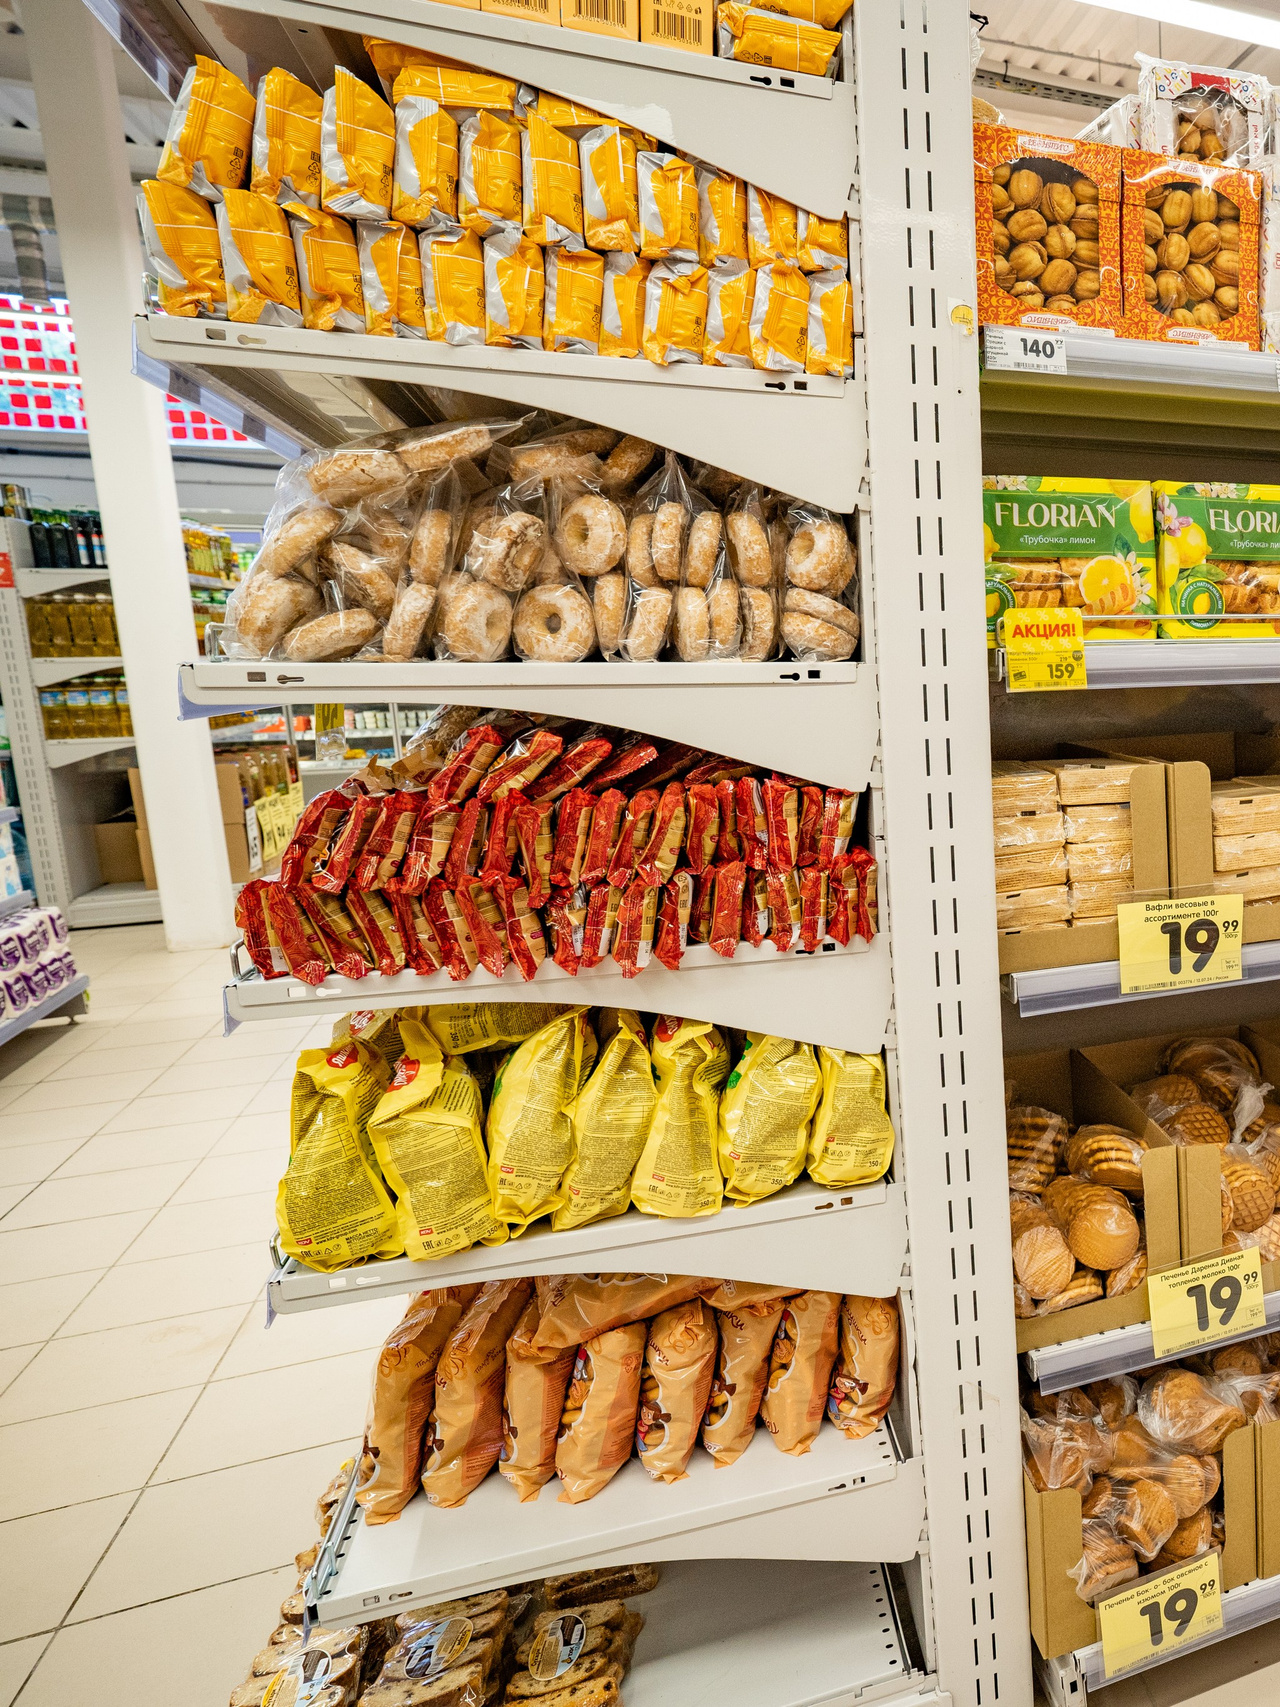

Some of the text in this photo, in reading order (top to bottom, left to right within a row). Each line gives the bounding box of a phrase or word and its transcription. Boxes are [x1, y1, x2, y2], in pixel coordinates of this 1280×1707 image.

[1020, 338, 1055, 359] 140
[995, 502, 1116, 528] FLORIAN
[1020, 535, 1096, 545] «Трубочка» лимон
[1230, 540, 1268, 550] «Трубочка»
[1012, 623, 1076, 639] АКЦИЯ!
[1047, 663, 1075, 679] 159
[1144, 909, 1219, 923] ассортименте 100г
[1145, 903, 1173, 912] Вафли
[1175, 901, 1208, 909] весовые
[1160, 918, 1239, 975] 19 99
[868, 1160, 879, 1168] 350
[771, 1178, 783, 1186] 350
[1160, 1254, 1244, 1282] Печенье Даренка Дивная
[1169, 1263, 1240, 1289] топленое молоко 100г
[1186, 1271, 1258, 1331] 19 99
[1104, 1594, 1135, 1611] Печенье
[1136, 1588, 1152, 1598] Бок-
[1162, 1576, 1175, 1586] бок
[1176, 1565, 1203, 1579] овсяное
[1137, 1582, 1182, 1606] изюмом 100г
[1140, 1579, 1216, 1647] 19 99
